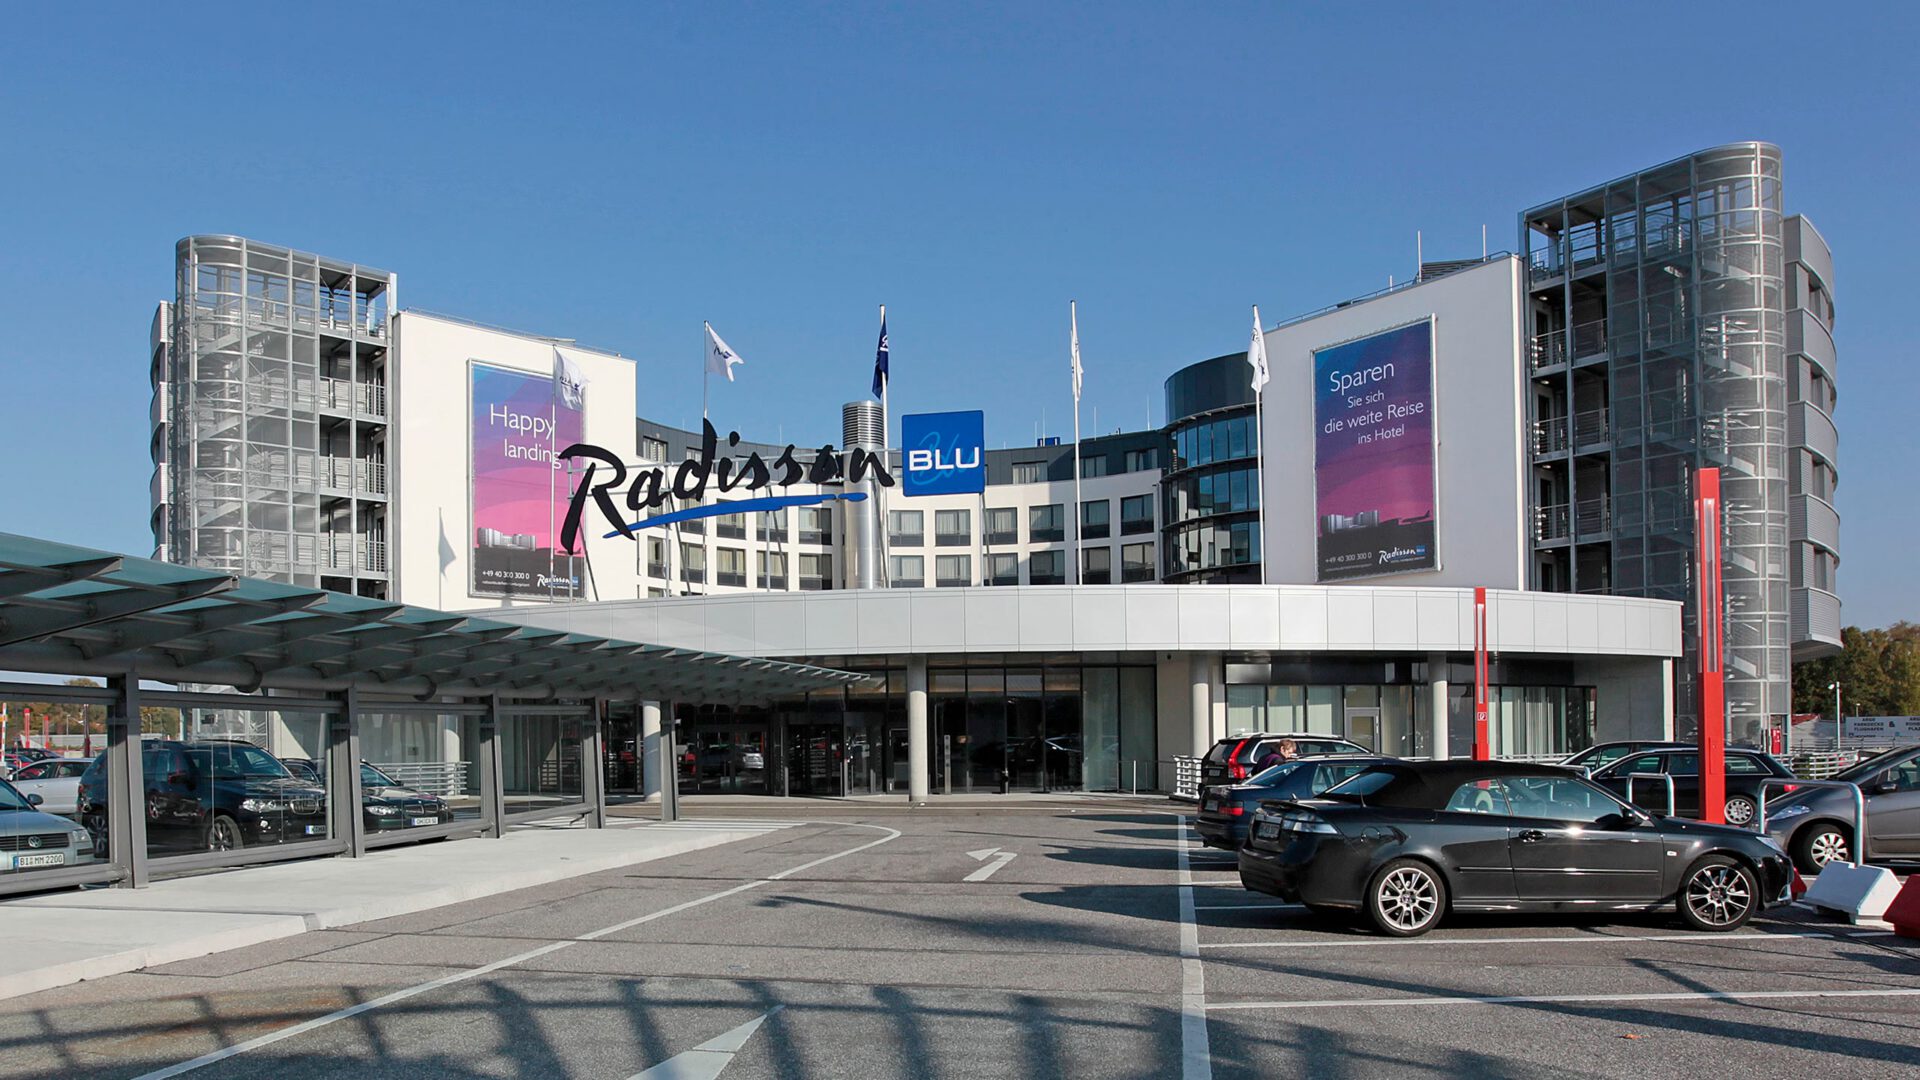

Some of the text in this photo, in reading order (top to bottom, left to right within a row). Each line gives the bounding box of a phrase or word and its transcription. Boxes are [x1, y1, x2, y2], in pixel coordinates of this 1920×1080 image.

[1330, 363, 1394, 396] Sparen
[1347, 390, 1385, 409] Sie sich
[490, 403, 556, 440] Happy
[1324, 401, 1424, 434] die weite Reise
[1358, 424, 1405, 445] ins Hotel
[557, 417, 980, 556] Radisson BLU
